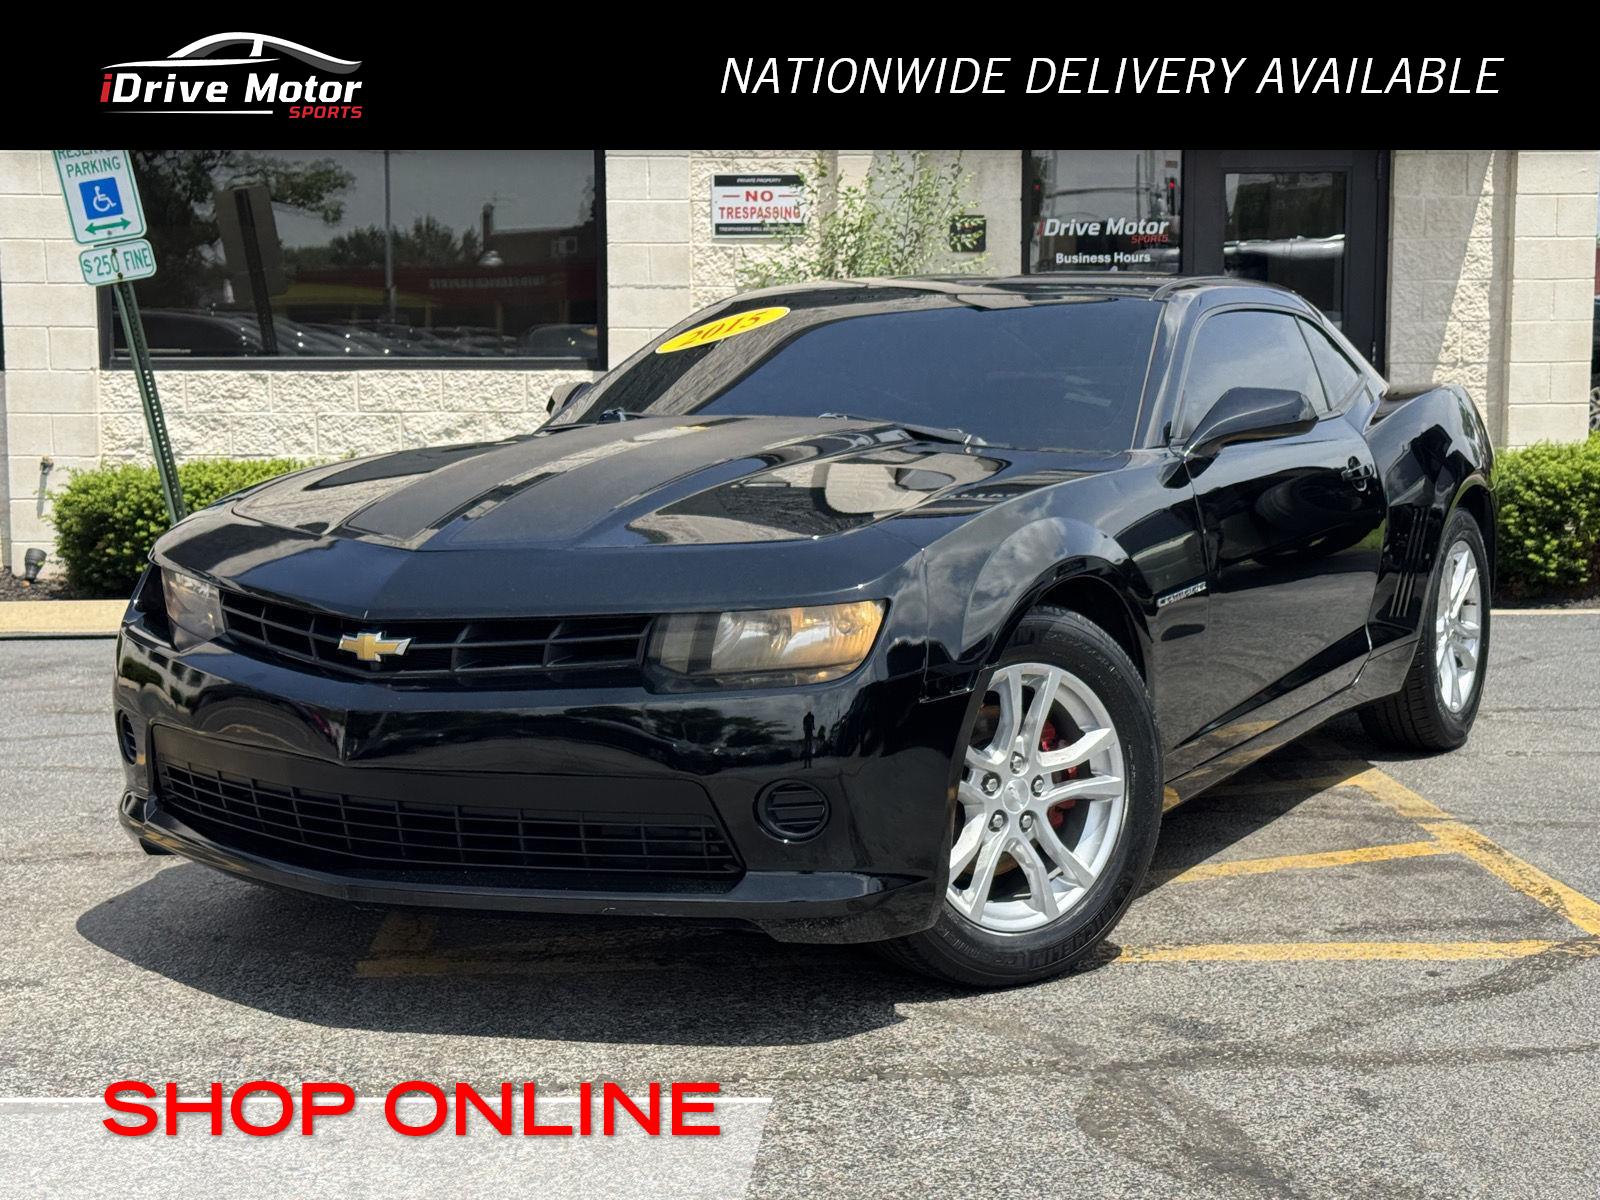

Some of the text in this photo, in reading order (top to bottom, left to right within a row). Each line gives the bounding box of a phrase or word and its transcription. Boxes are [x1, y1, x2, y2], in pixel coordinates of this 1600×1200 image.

[65, 156, 121, 178] PARKING
[745, 190, 774, 202] NO
[1105, 217, 1169, 236] Motor
[1130, 234, 1169, 245] SPORTS
[123, 247, 152, 271] FINE
[1055, 252, 1151, 264] Business Hours
[678, 311, 769, 348] 2015
